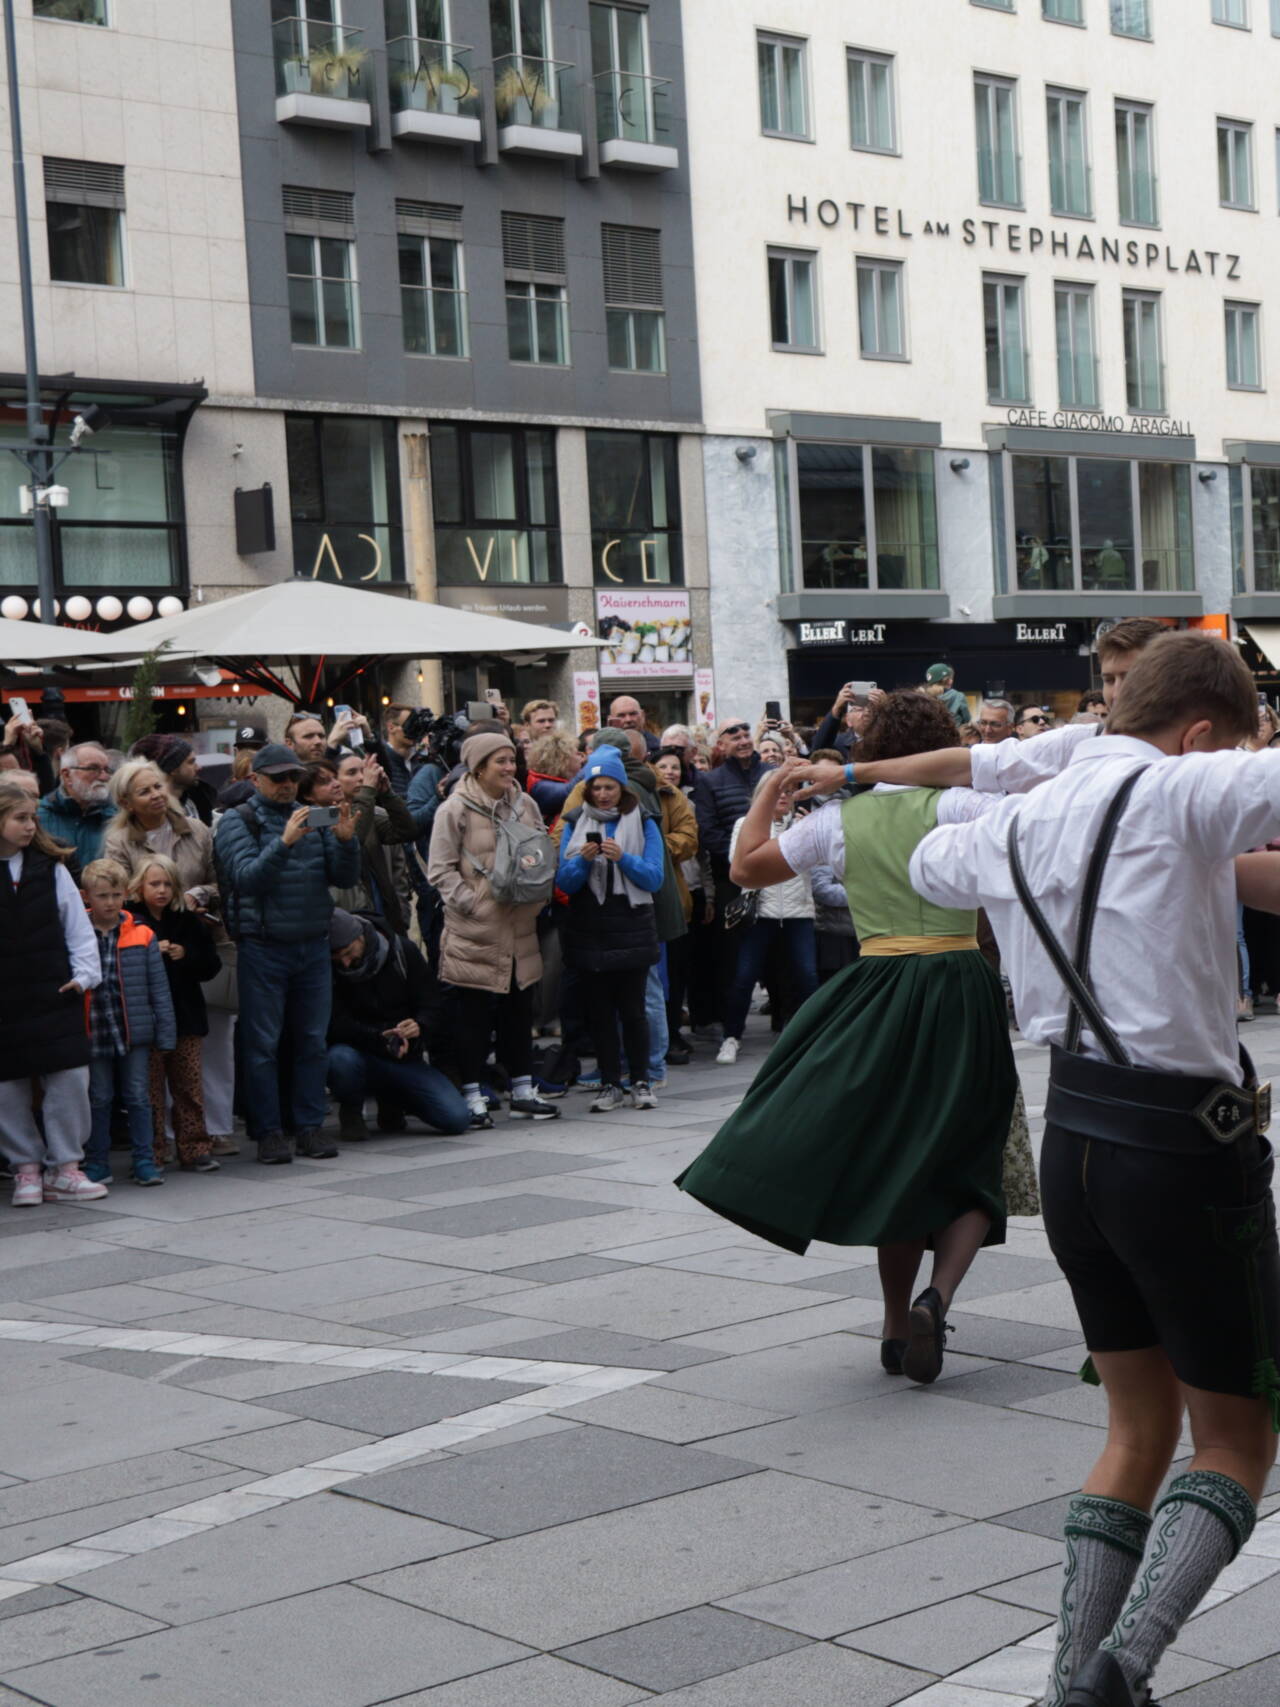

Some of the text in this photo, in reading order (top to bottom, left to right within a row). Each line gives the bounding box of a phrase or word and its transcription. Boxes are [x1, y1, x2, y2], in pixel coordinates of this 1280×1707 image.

[786, 193, 1242, 280] HOTEL AM STEPHANSPLATZ
[1007, 408, 1196, 438] CAFE GIACOMO ARAGALL
[850, 623, 887, 642] LERT
